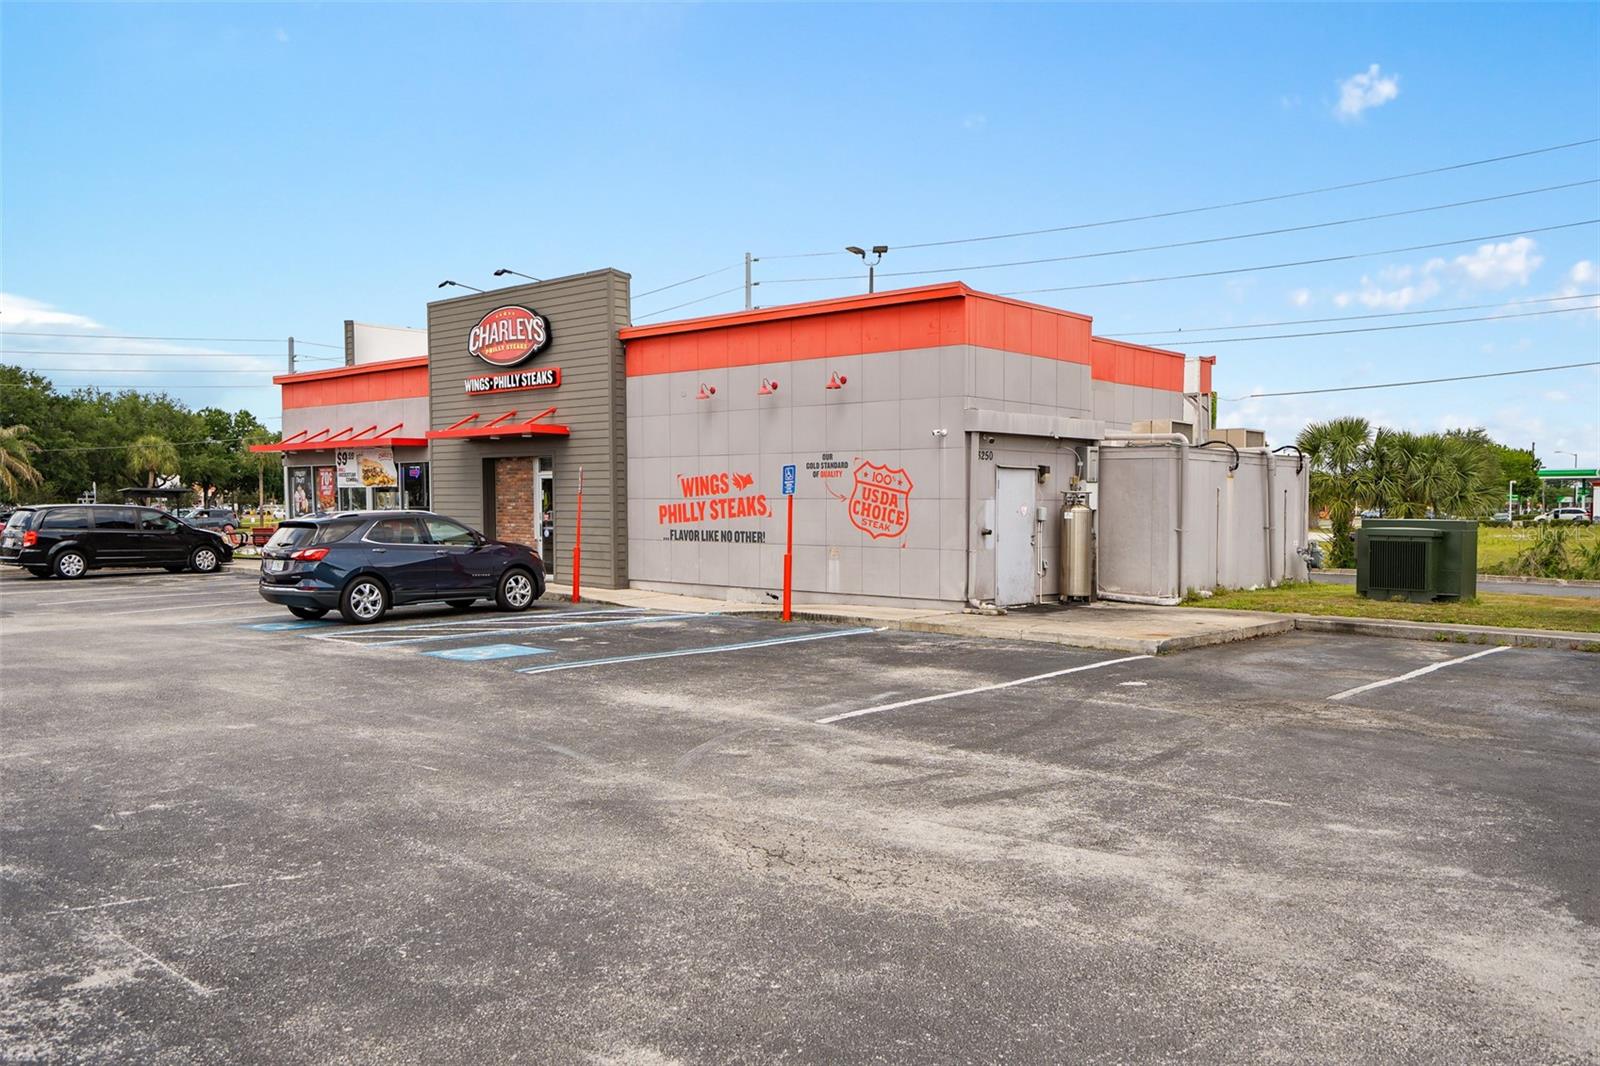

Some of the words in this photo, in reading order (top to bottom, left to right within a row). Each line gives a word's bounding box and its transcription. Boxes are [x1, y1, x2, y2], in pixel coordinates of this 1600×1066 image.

[469, 317, 545, 353] CHARLEYS
[484, 345, 505, 354] PHILLY
[505, 342, 529, 350] STEAKS
[464, 376, 490, 392] WINGS
[493, 374, 521, 389] PHILLY
[521, 370, 554, 386] STEAKS
[820, 461, 849, 469] STANDARD
[822, 453, 833, 461] OUR
[819, 470, 843, 478] QUALITY
[680, 473, 730, 498] WINGS
[862, 486, 899, 509] USDA
[658, 501, 706, 525] PHILLY
[709, 494, 768, 520] STEAKS
[852, 500, 905, 527] CHOICE
[861, 518, 891, 532] STEAK
[701, 529, 719, 542] LIKE
[720, 530, 733, 543] NO
[734, 530, 766, 544] OTHER!
